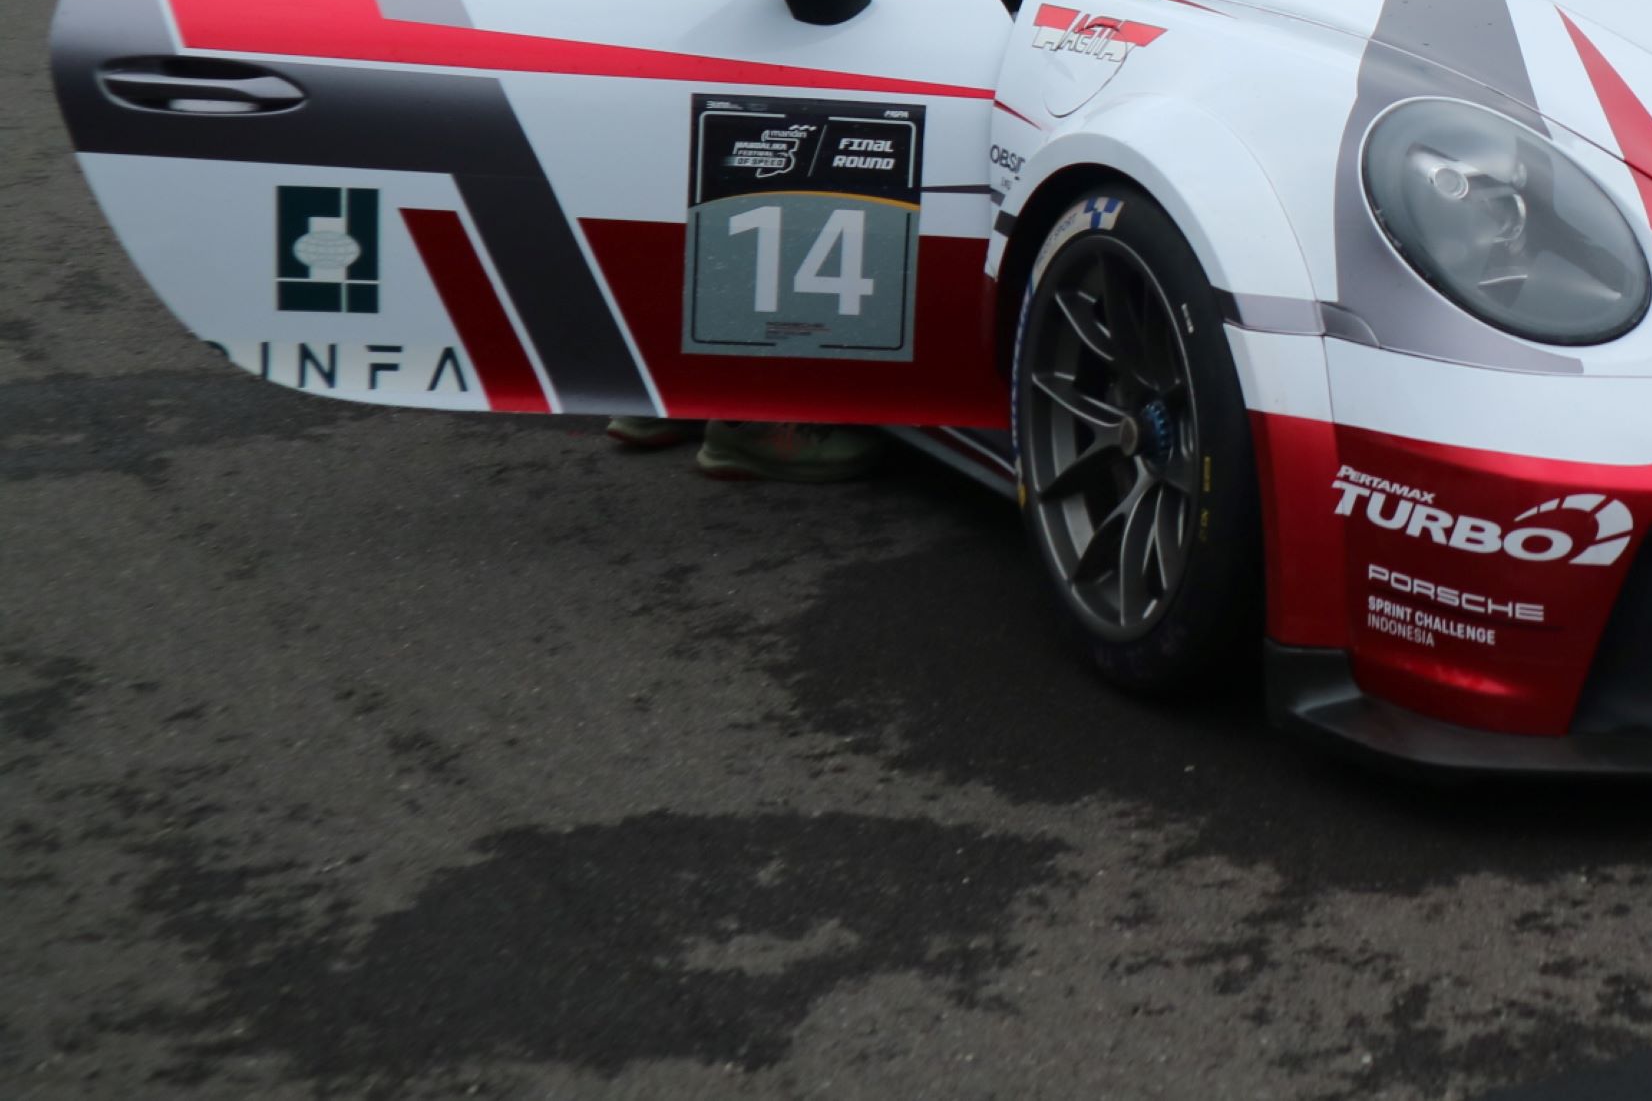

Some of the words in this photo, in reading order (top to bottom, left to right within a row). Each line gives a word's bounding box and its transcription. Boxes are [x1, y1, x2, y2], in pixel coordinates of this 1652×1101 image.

[832, 155, 896, 171] ROUND
[728, 206, 874, 316] 14
[1335, 464, 1436, 505] PERTAMAX
[1331, 480, 1574, 562] TURBO
[1367, 563, 1545, 622] PORSCHE
[1366, 613, 1436, 648] INDONESIA
[1367, 595, 1413, 622] SPRINT
[1414, 607, 1497, 646] CHALLENGE
